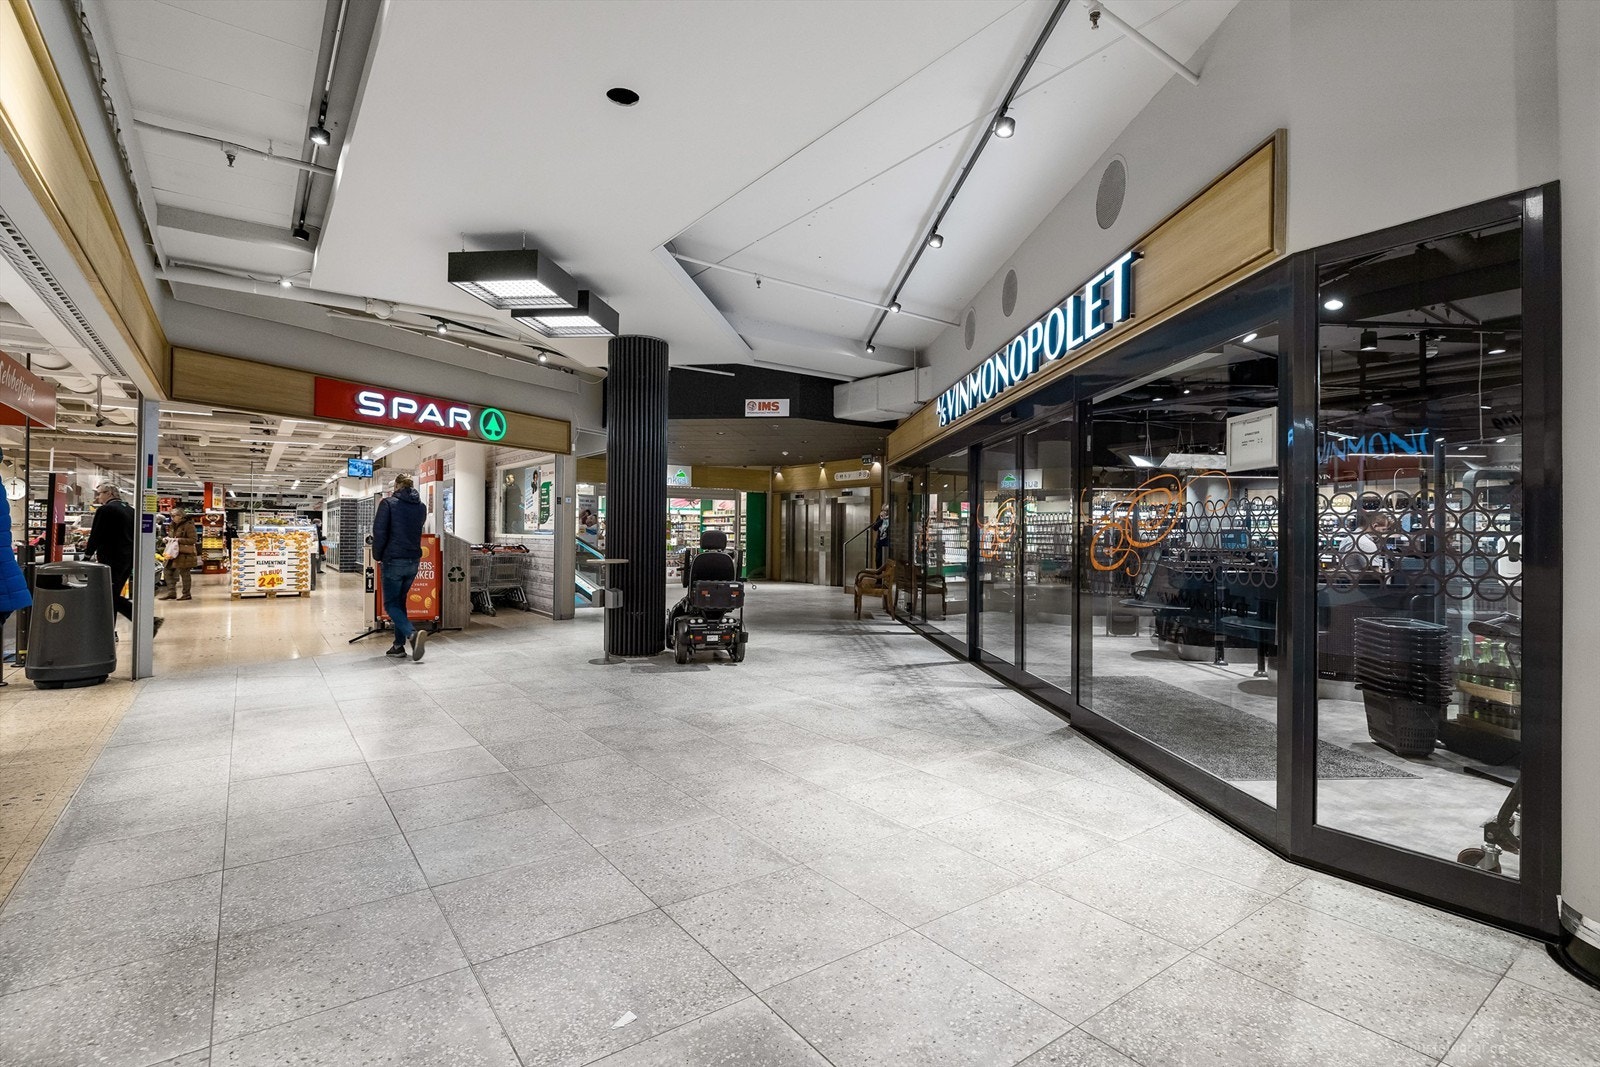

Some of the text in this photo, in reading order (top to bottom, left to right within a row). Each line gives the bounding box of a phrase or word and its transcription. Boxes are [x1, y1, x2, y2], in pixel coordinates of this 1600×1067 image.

[945, 250, 1138, 423] VINMONOPOLET
[355, 390, 472, 431] SPAR
[757, 401, 780, 411] IMS
